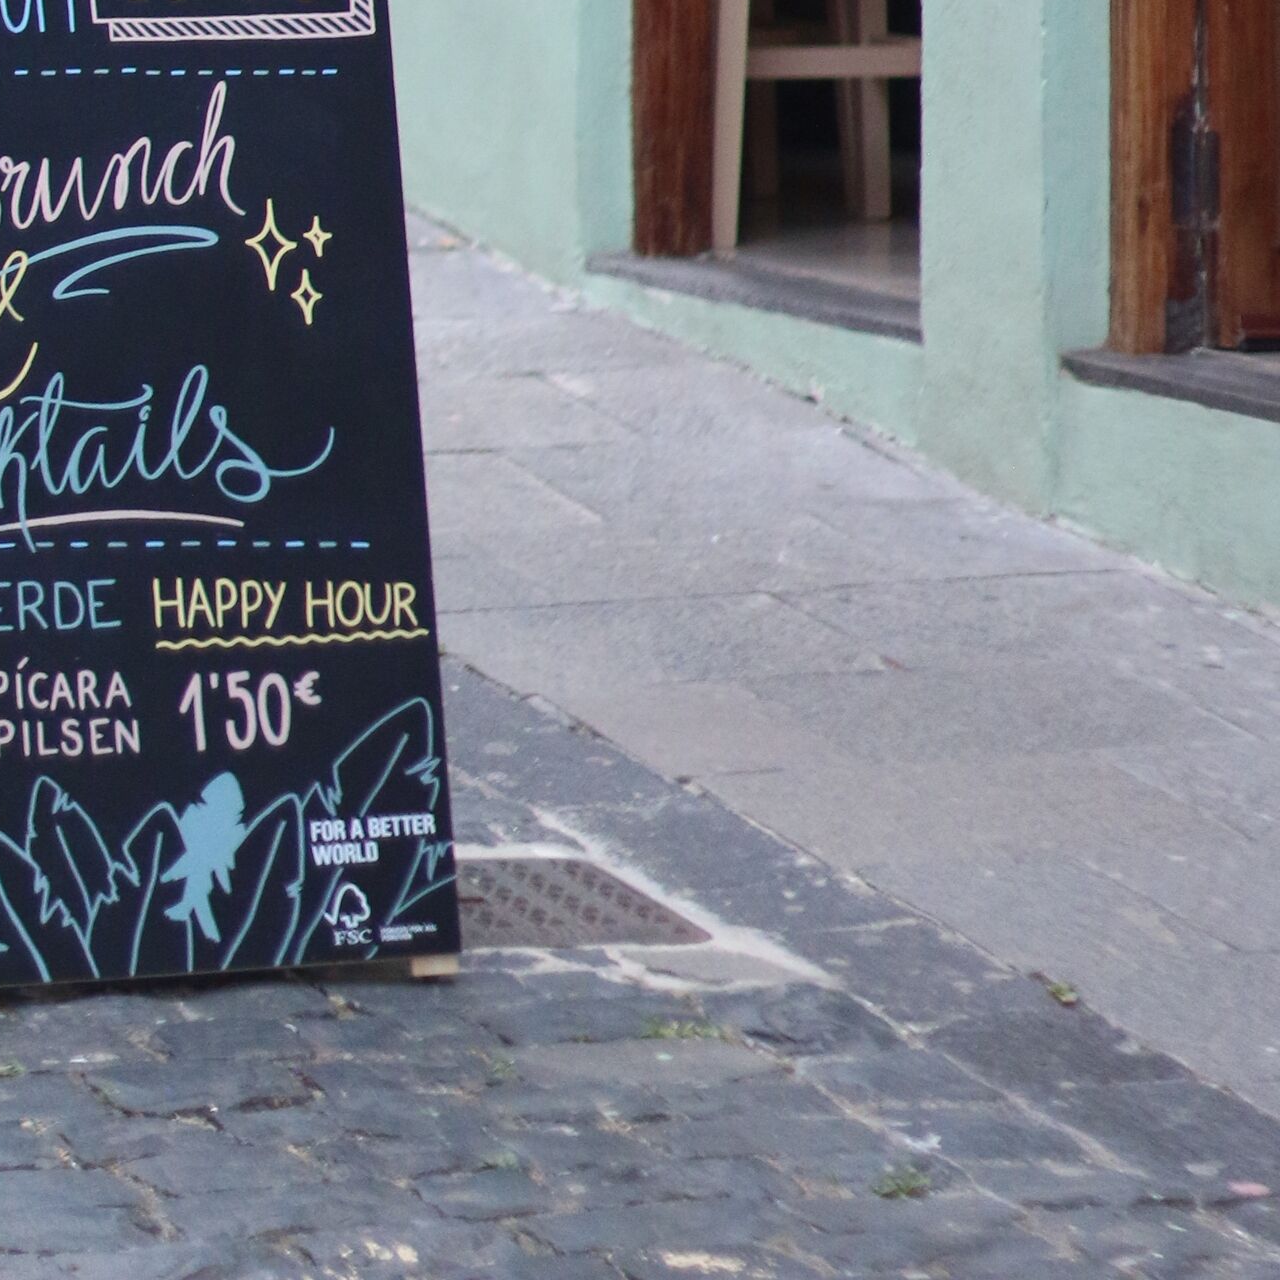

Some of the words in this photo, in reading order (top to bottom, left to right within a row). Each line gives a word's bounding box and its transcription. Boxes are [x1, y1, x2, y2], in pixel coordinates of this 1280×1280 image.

[152, 577, 287, 629] HAPPY
[305, 580, 418, 628] HOUR
[309, 818, 347, 842] FOR
[350, 817, 365, 840] A
[367, 813, 437, 839] BETTER
[311, 841, 380, 866] WORLD
[333, 928, 373, 947] FSC
